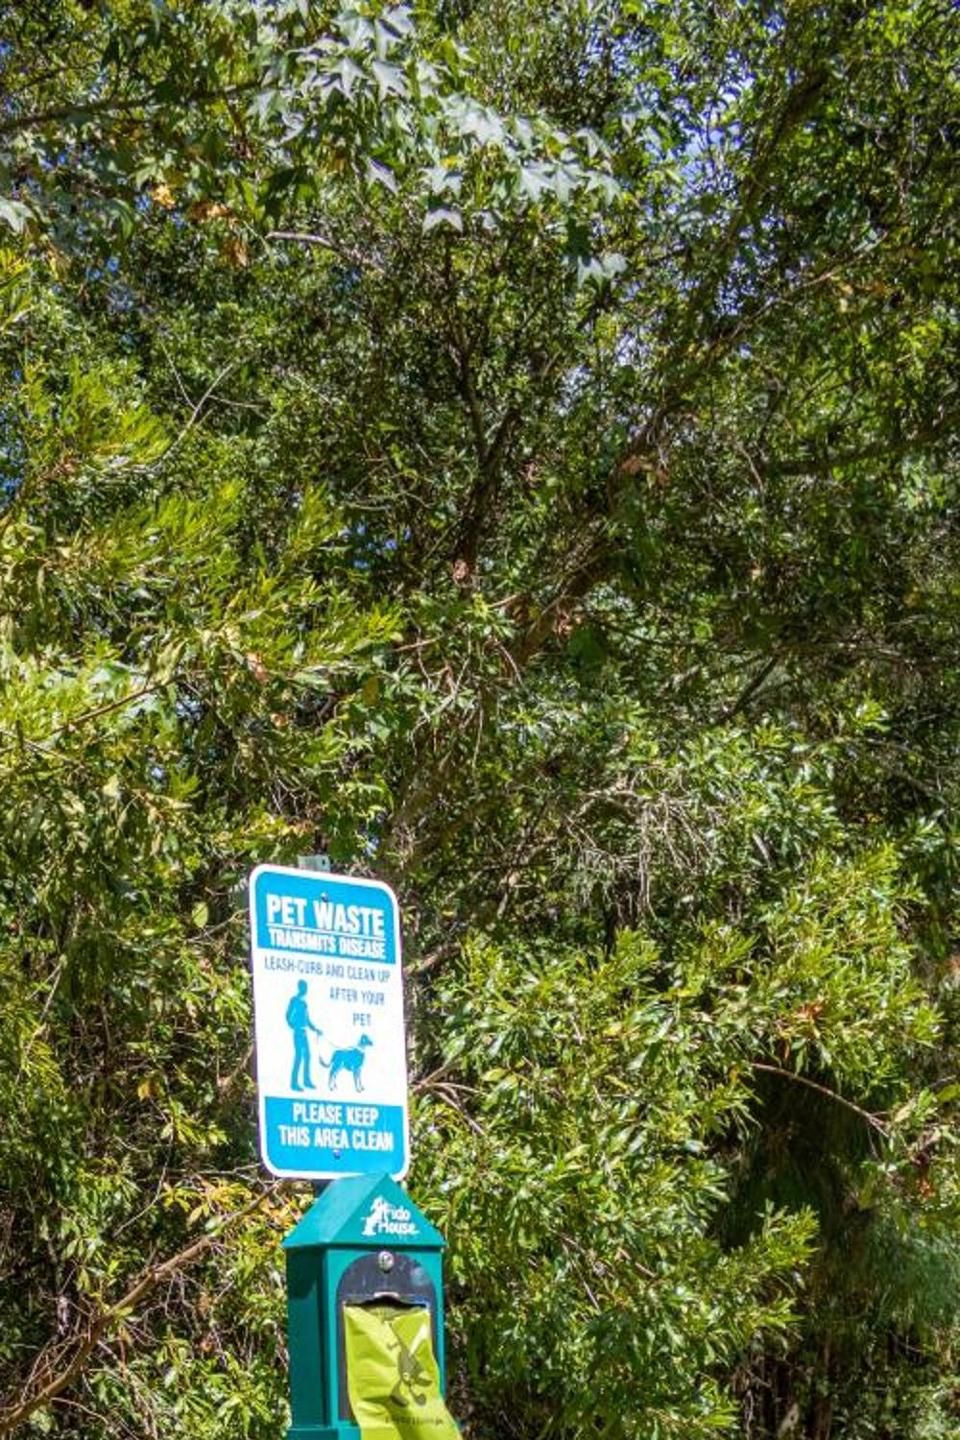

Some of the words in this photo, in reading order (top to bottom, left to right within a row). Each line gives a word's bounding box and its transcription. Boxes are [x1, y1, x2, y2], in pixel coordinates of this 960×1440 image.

[266, 894, 307, 927] PET
[313, 900, 385, 938] WASTE
[269, 928, 336, 953] TRANSMITS
[339, 937, 386, 959] DISEASE
[326, 963, 344, 979] AND
[347, 965, 375, 982] CLEAN
[377, 969, 390, 983] UP
[329, 986, 358, 1003] AFTER
[361, 989, 385, 1006] YOUR
[352, 1012, 371, 1027] PET
[293, 1102, 342, 1125] PLEASE
[346, 1106, 379, 1127] KEEP
[278, 1124, 311, 1147] THIS
[314, 1128, 350, 1149] AREA
[352, 1129, 394, 1152] CLEAN
